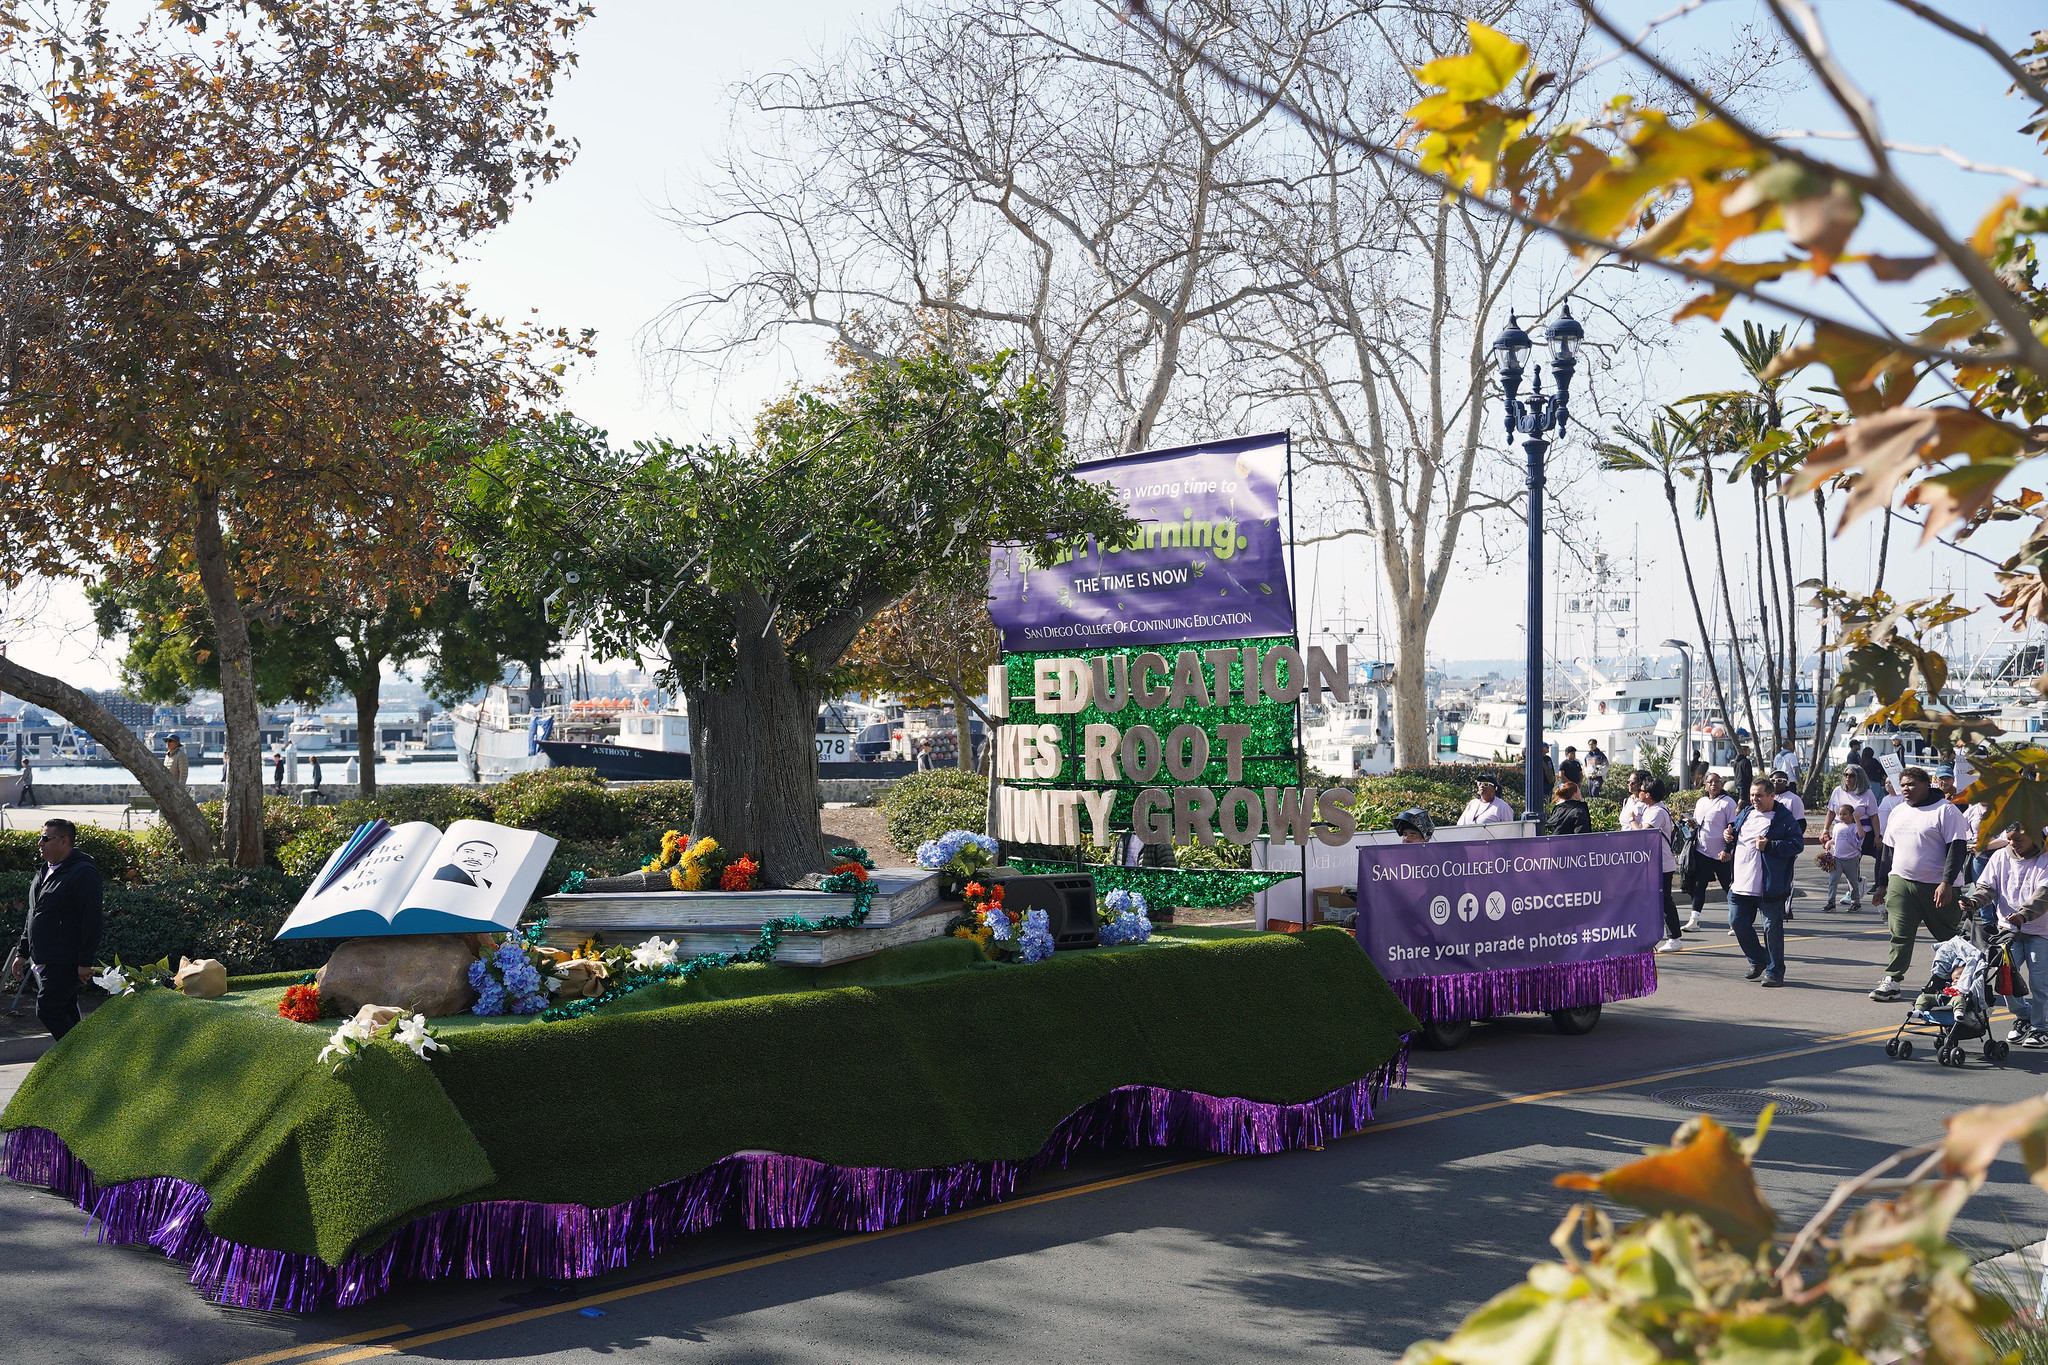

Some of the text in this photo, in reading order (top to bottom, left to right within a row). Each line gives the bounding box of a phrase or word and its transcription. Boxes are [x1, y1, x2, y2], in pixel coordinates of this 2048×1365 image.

[1122, 488, 1131, 500] a
[1135, 482, 1180, 499] wrong
[1183, 477, 1217, 494] time
[1221, 479, 1237, 494] to
[1074, 568, 1188, 594] THE TIME IS NOW
[1034, 644, 1350, 715] EDUCATION
[592, 747, 631, 757] ANTHONY
[1084, 723, 1251, 783] ROOT
[1132, 787, 1357, 848] GROWS
[1511, 890, 1602, 915] @SDCCEEDU
[1388, 923, 1637, 962] Share your parade photos #SDMLK
